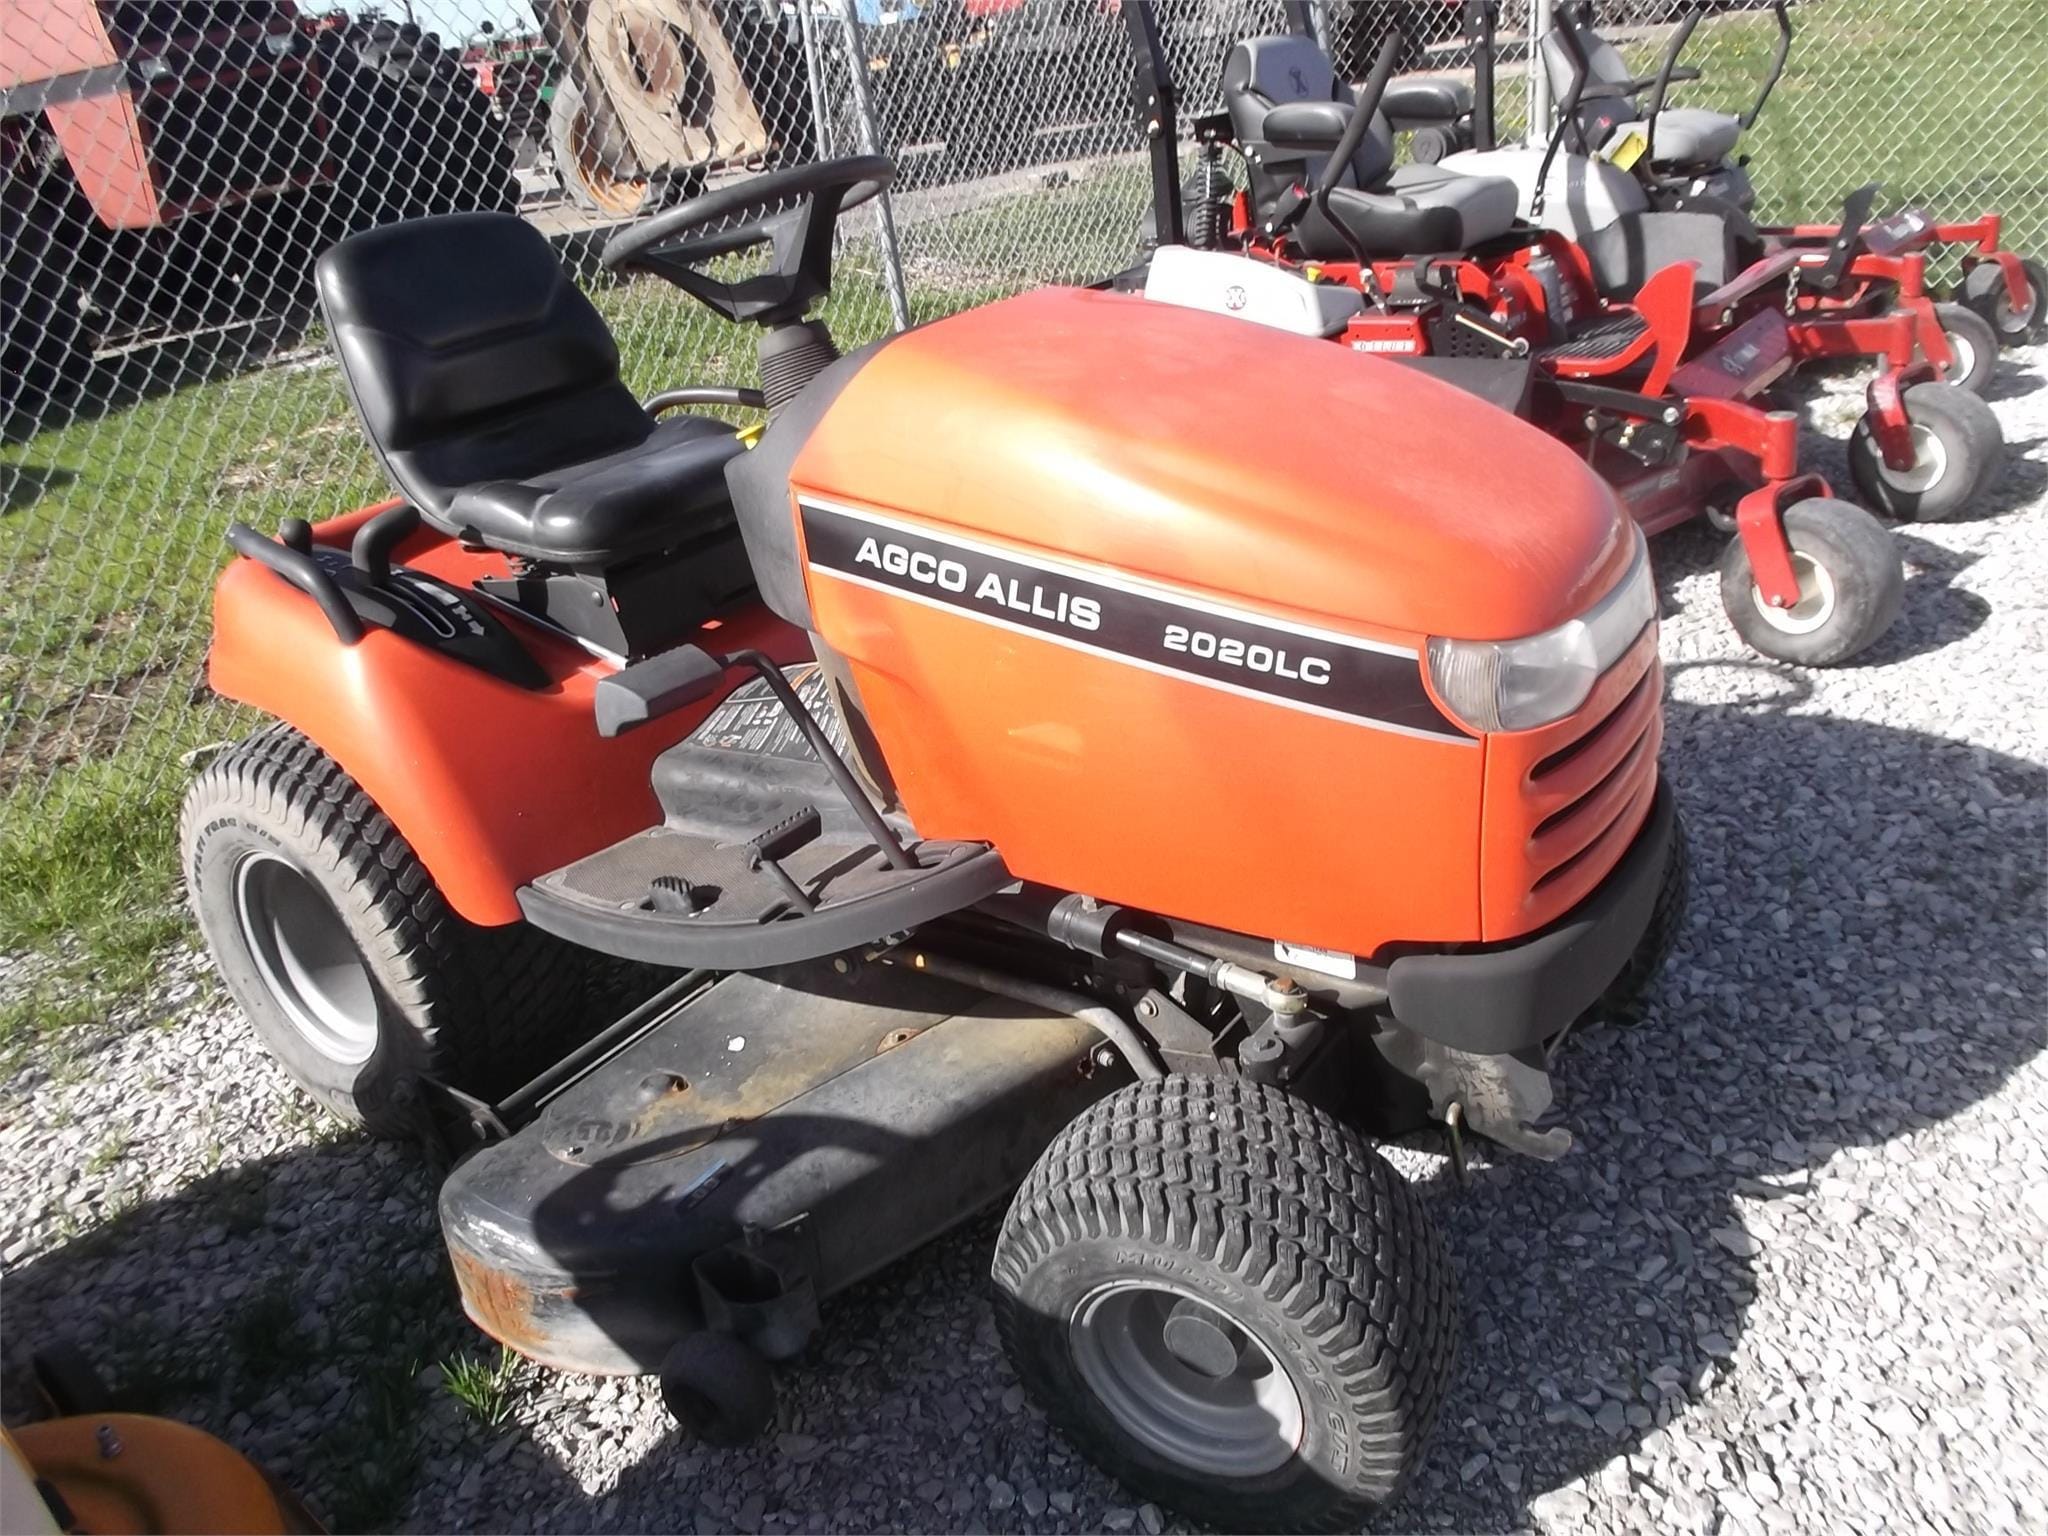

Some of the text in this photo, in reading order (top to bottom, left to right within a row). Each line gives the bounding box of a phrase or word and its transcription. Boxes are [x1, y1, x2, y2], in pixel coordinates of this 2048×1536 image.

[854, 537, 1102, 632] AGCO ALLIS
[1162, 624, 1332, 686] 2020LC
